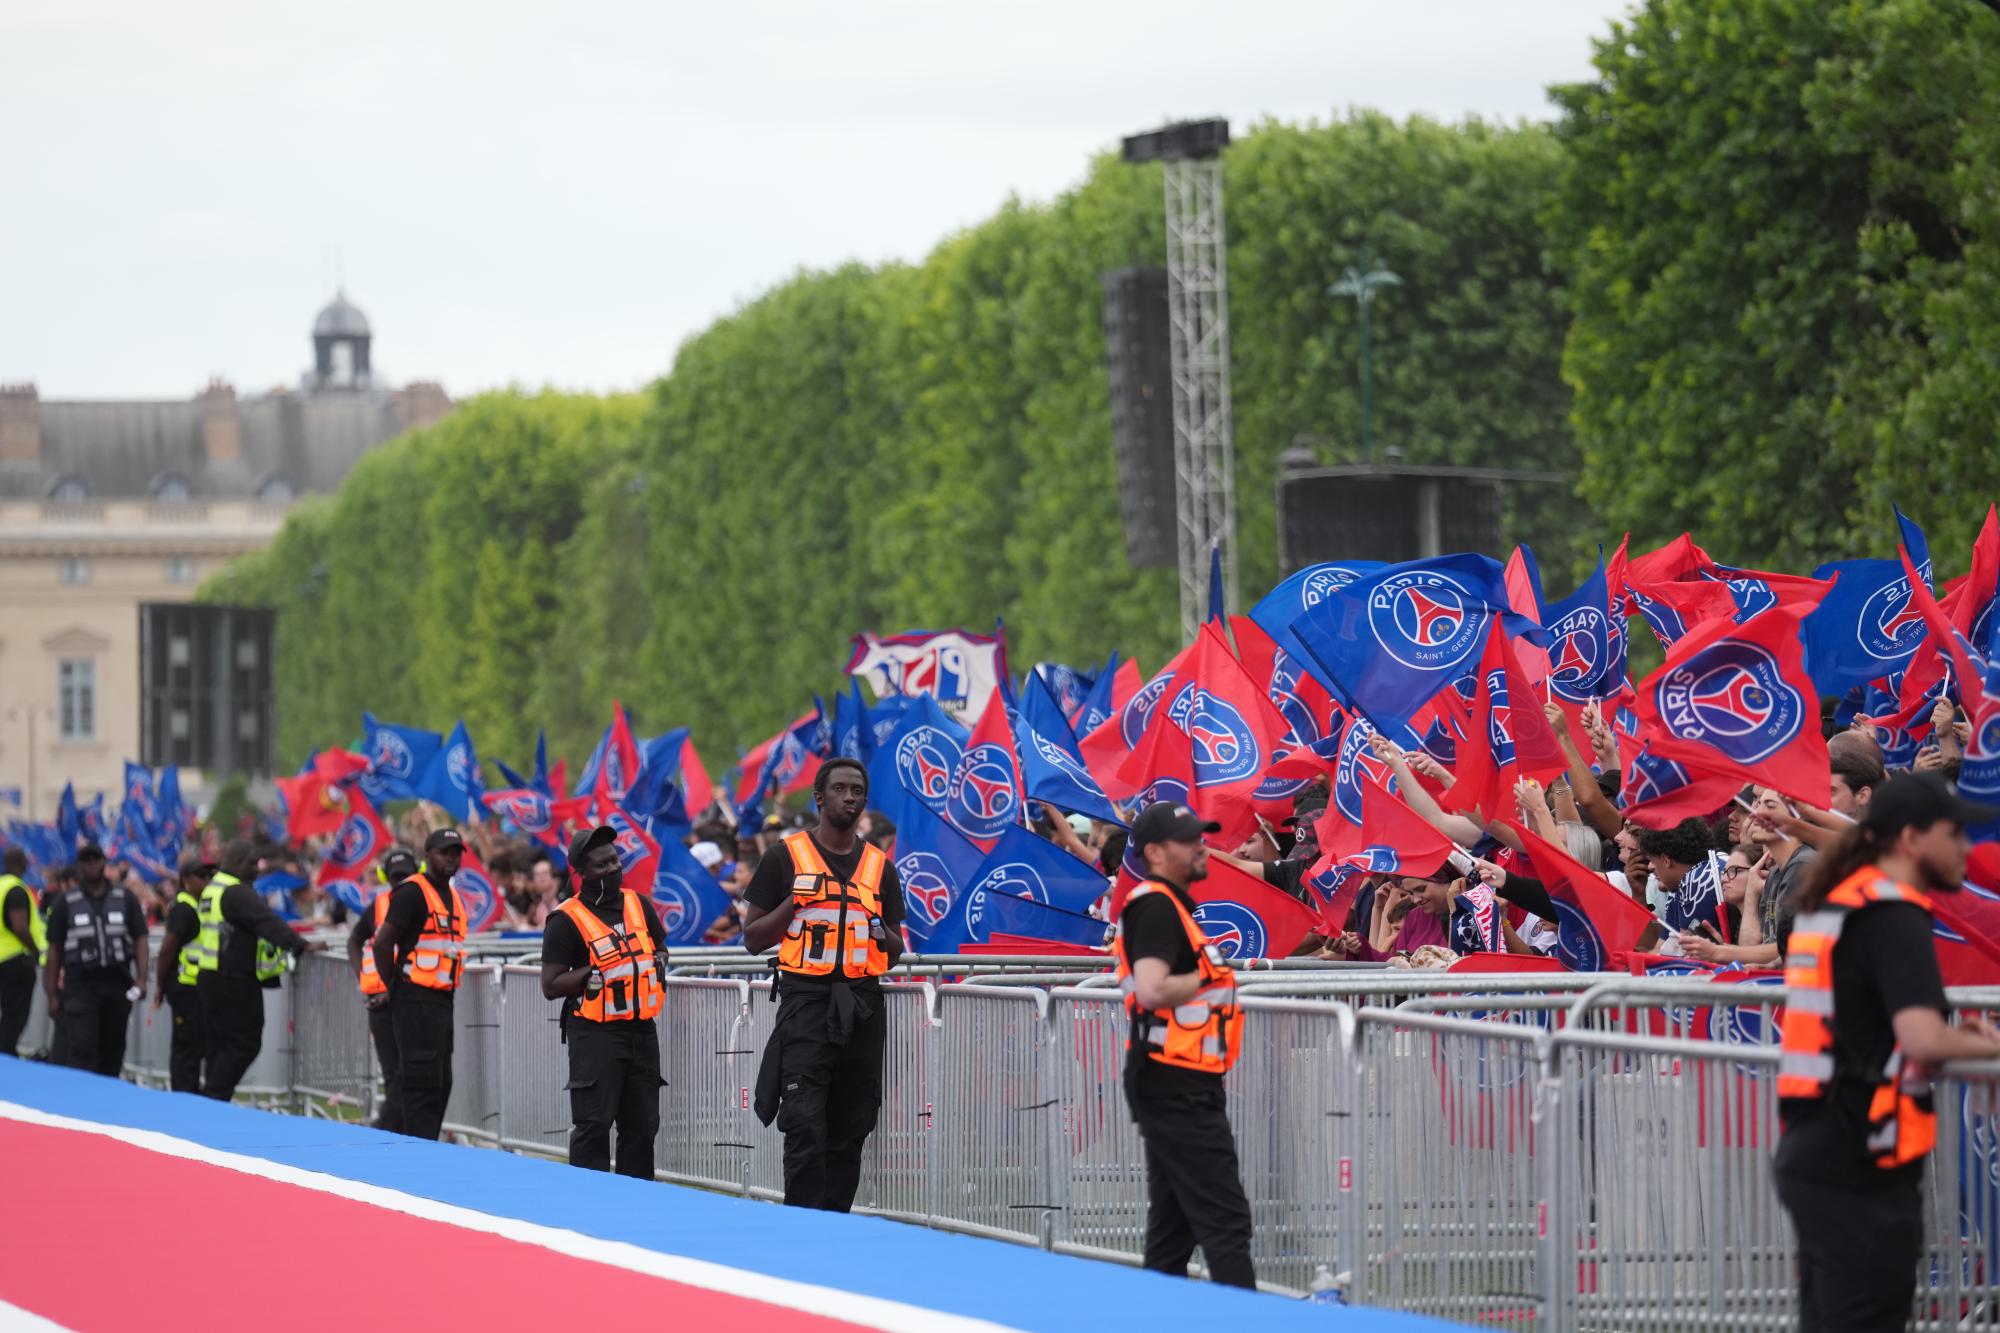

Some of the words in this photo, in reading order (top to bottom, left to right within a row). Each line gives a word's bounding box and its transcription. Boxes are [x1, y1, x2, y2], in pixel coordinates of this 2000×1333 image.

[1415, 651, 1444, 661] SAINT
[1451, 613, 1479, 652] GERMAIN
[1666, 668, 1705, 739] PARIS
[1768, 707, 1789, 737] SAINT
